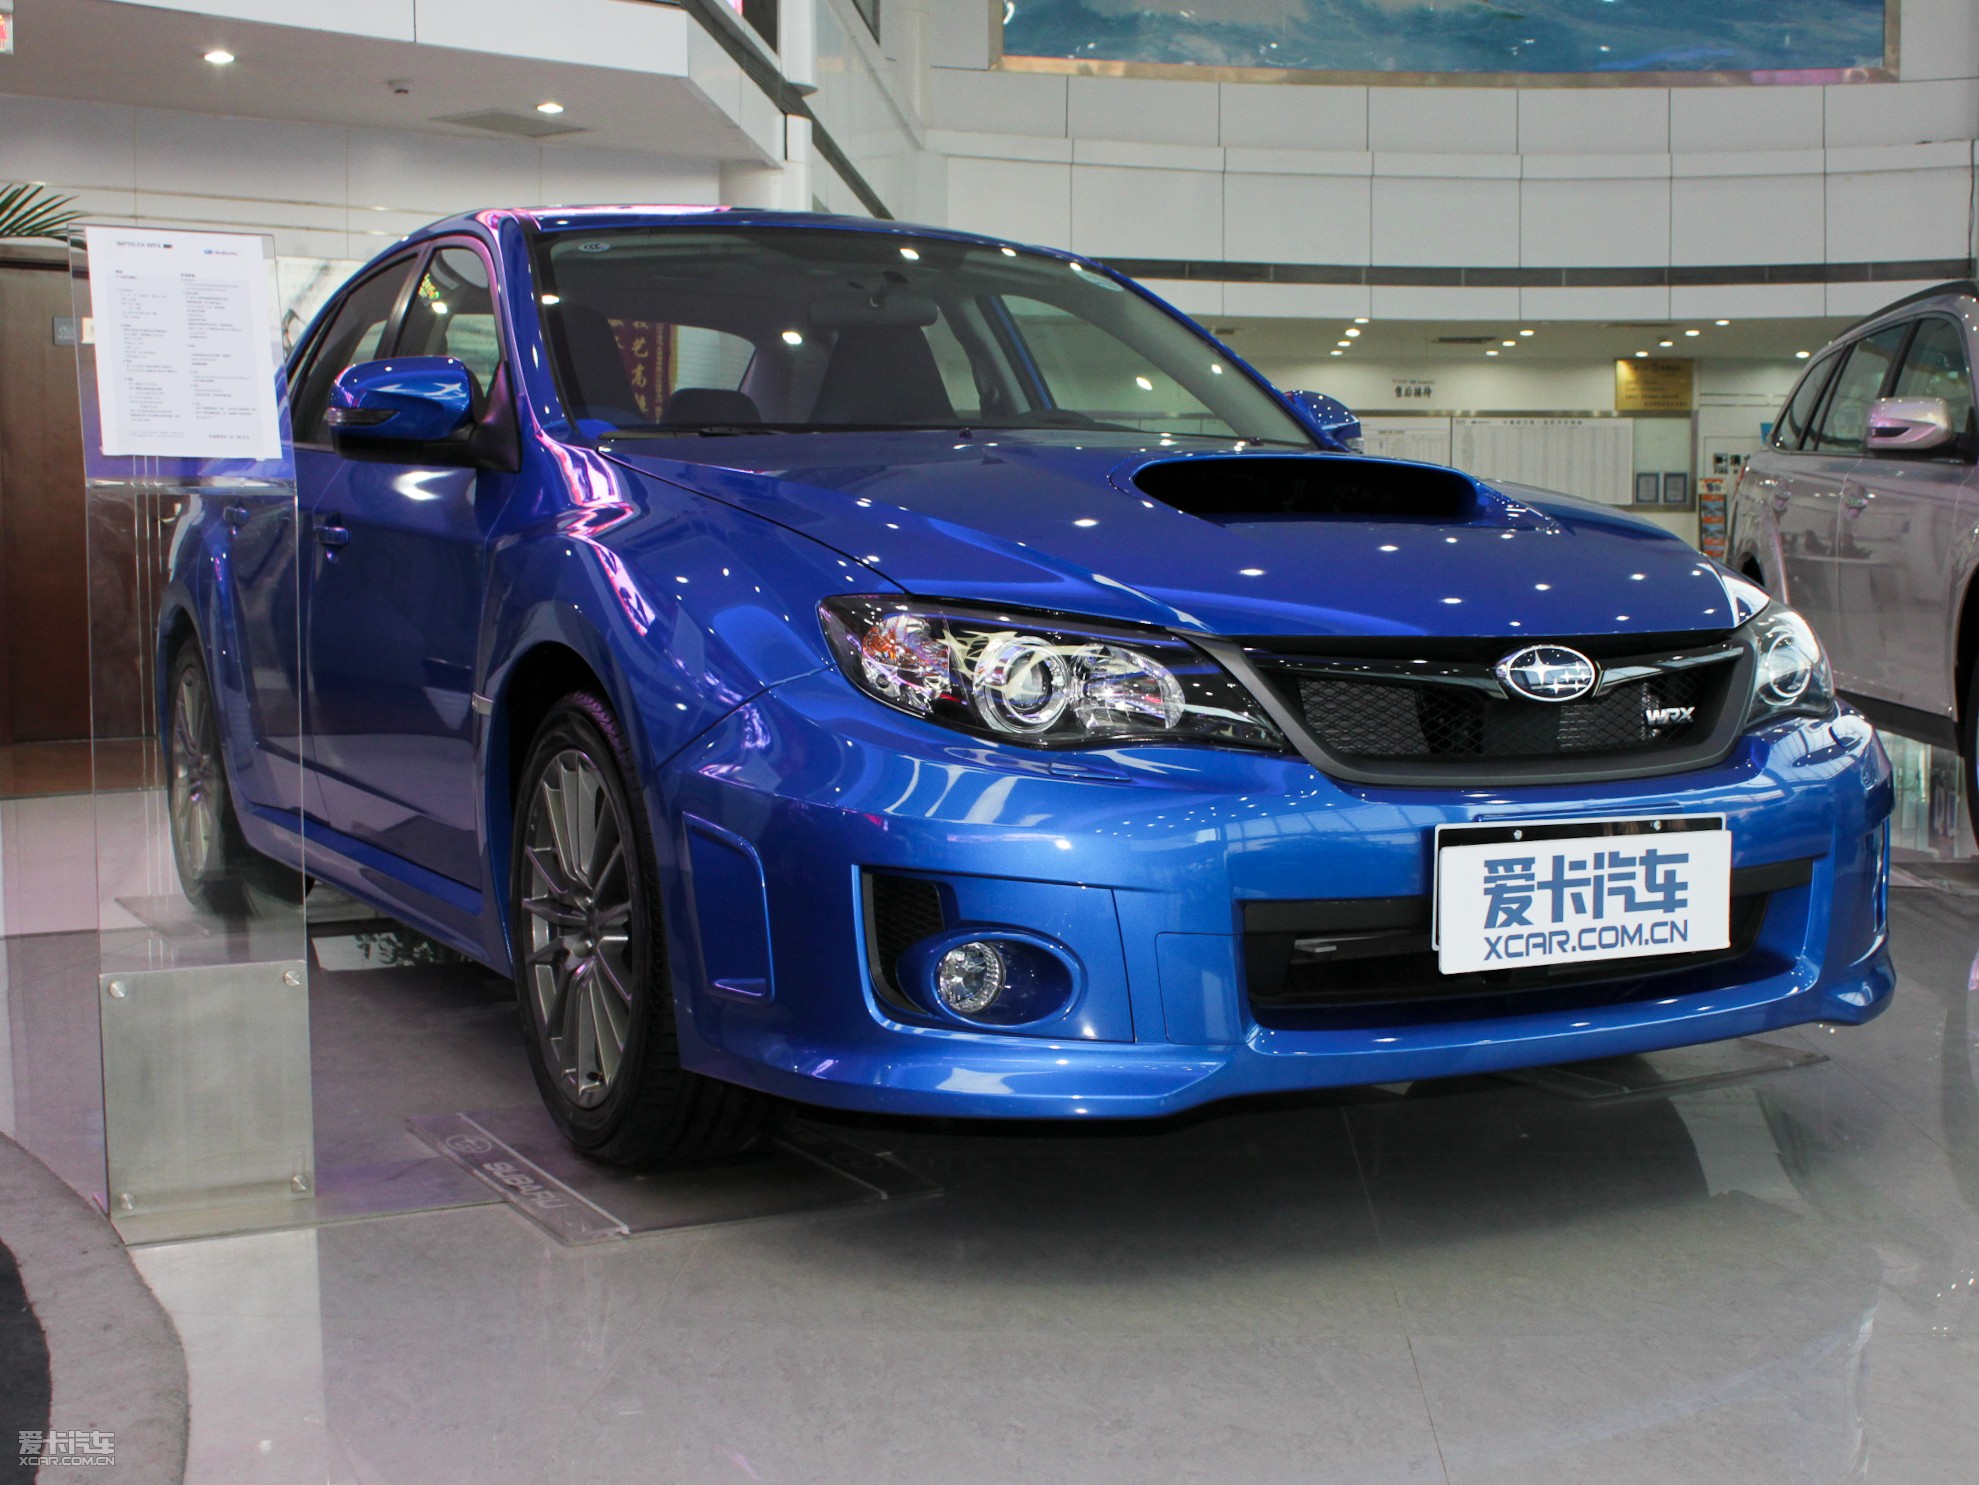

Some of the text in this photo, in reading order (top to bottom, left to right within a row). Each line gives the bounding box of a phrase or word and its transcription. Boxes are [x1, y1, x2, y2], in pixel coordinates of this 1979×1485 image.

[1645, 706, 1696, 724] WRX
[1483, 849, 1690, 929] 爱卡汽车
[1483, 919, 1689, 961] XCAR.COM.CN
[482, 1162, 569, 1209] SUBARU
